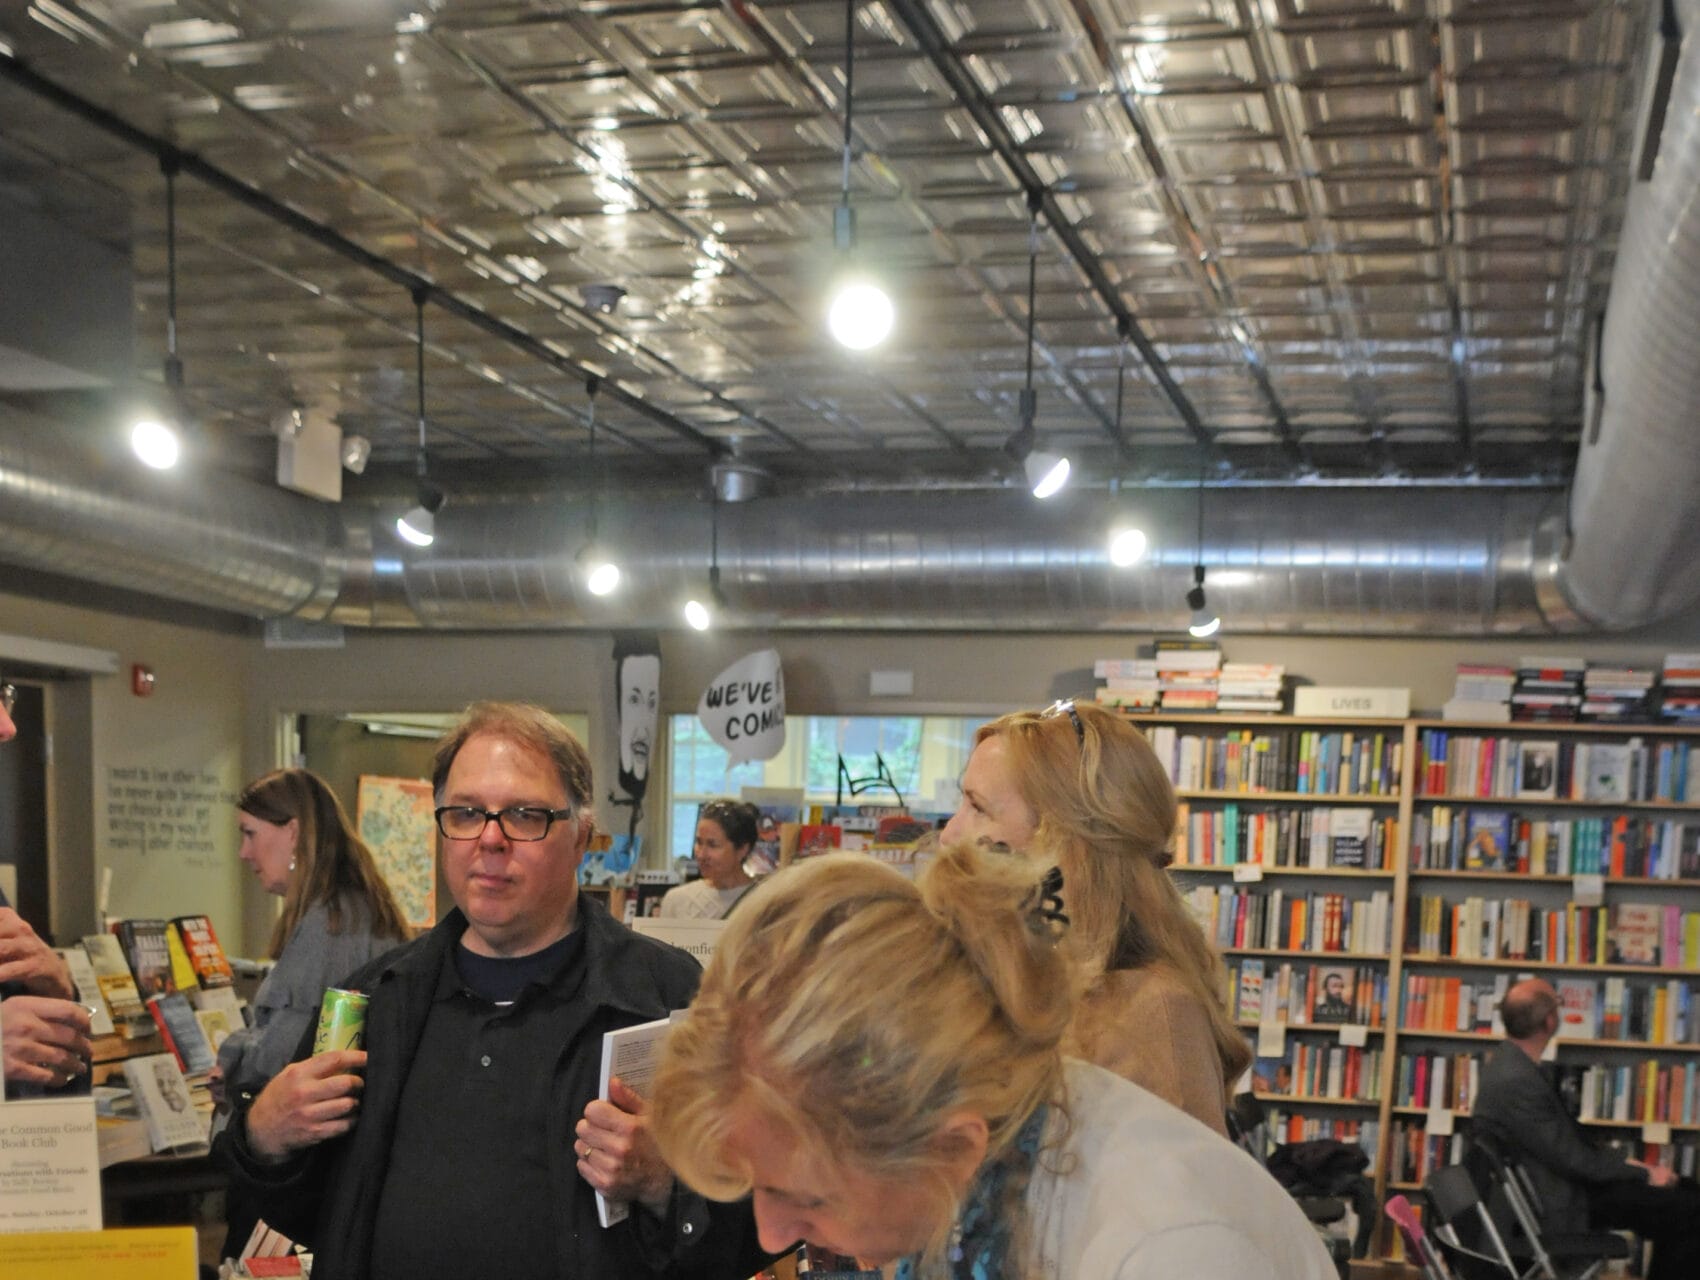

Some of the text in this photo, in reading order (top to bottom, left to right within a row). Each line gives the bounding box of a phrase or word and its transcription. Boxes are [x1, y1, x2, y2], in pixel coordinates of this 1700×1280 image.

[707, 682, 772, 708] WE'VE
[1331, 698, 1371, 709] LIVES
[726, 707, 784, 740] COM
[11, 1123, 92, 1135] Common Good
[1, 1137, 57, 1149] Book Club
